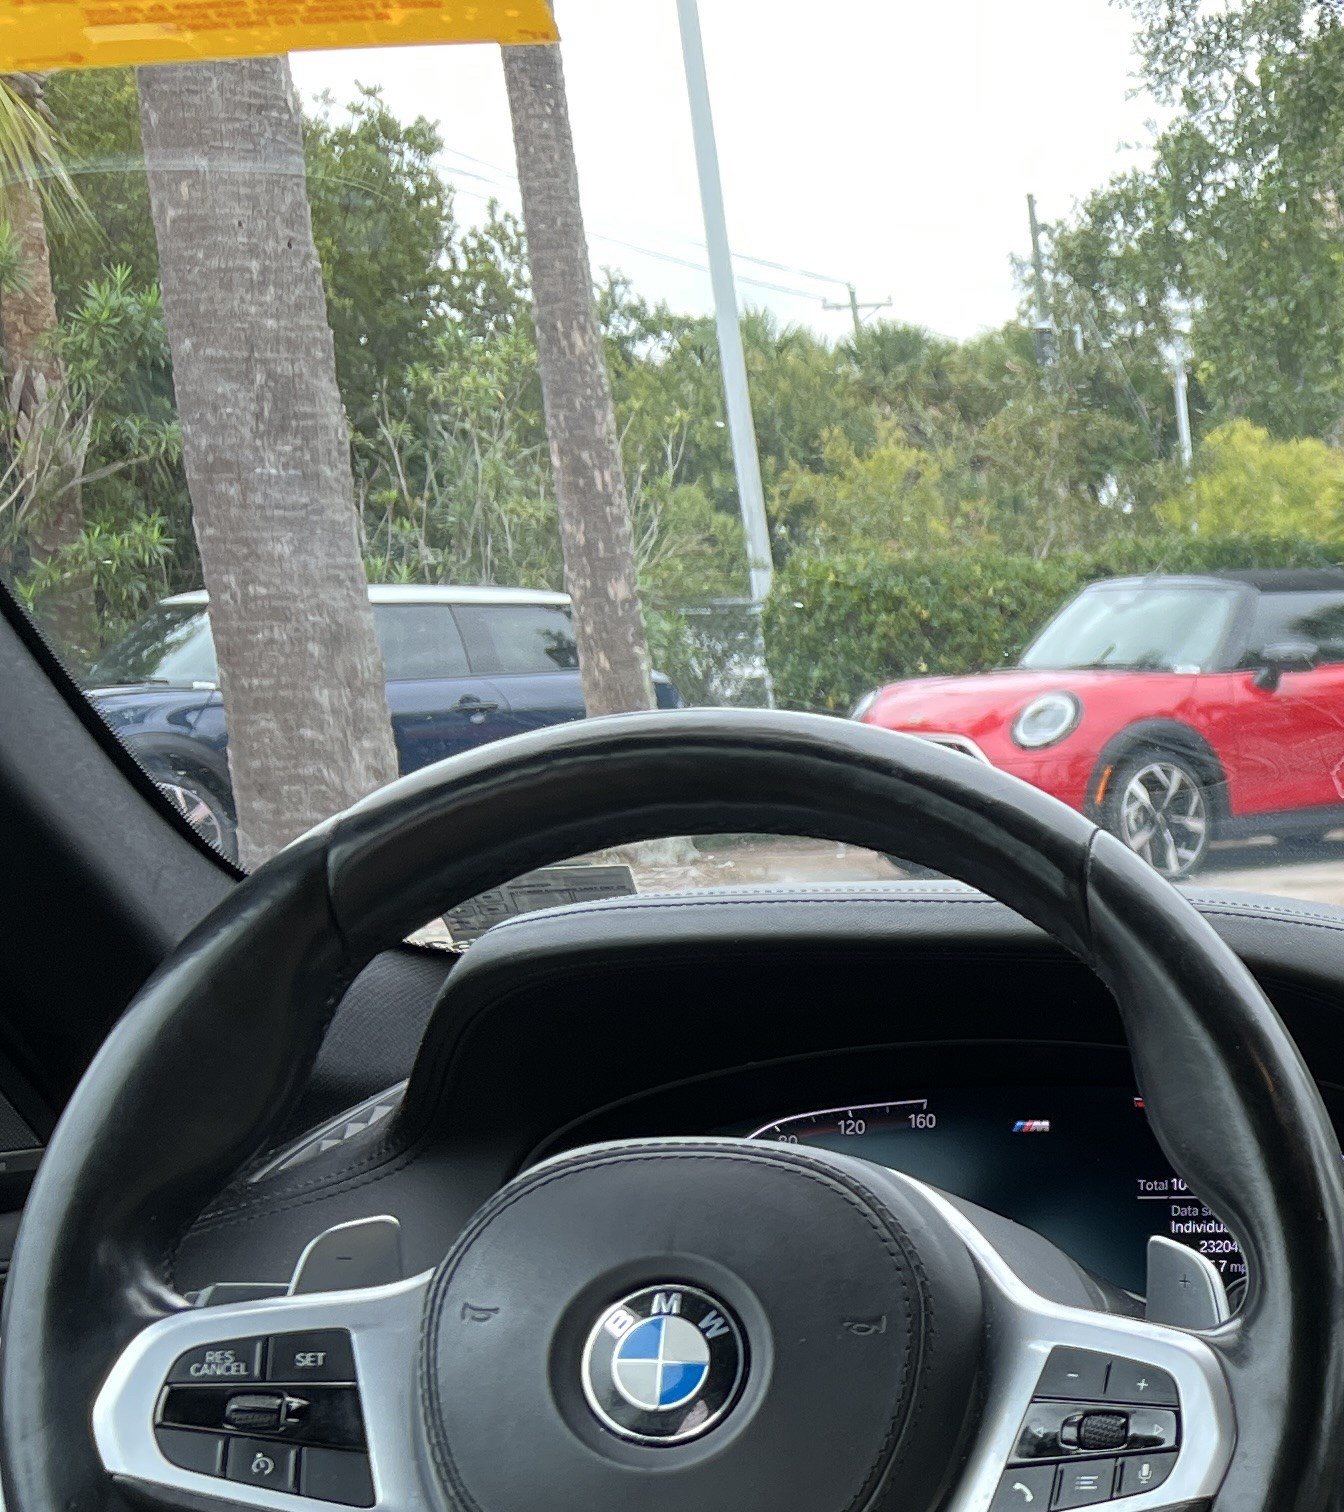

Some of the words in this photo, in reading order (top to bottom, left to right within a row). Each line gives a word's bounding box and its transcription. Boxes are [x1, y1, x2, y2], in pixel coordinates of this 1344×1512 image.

[838, 1120, 865, 1134] 120
[908, 1113, 936, 1128] 160
[1138, 1179, 1168, 1191] Total
[1171, 1205, 1199, 1217] Data
[603, 1291, 729, 1340] BMW
[205, 1350, 236, 1364] RES
[295, 1352, 327, 1367] SET
[190, 1363, 249, 1377] CANCEL
